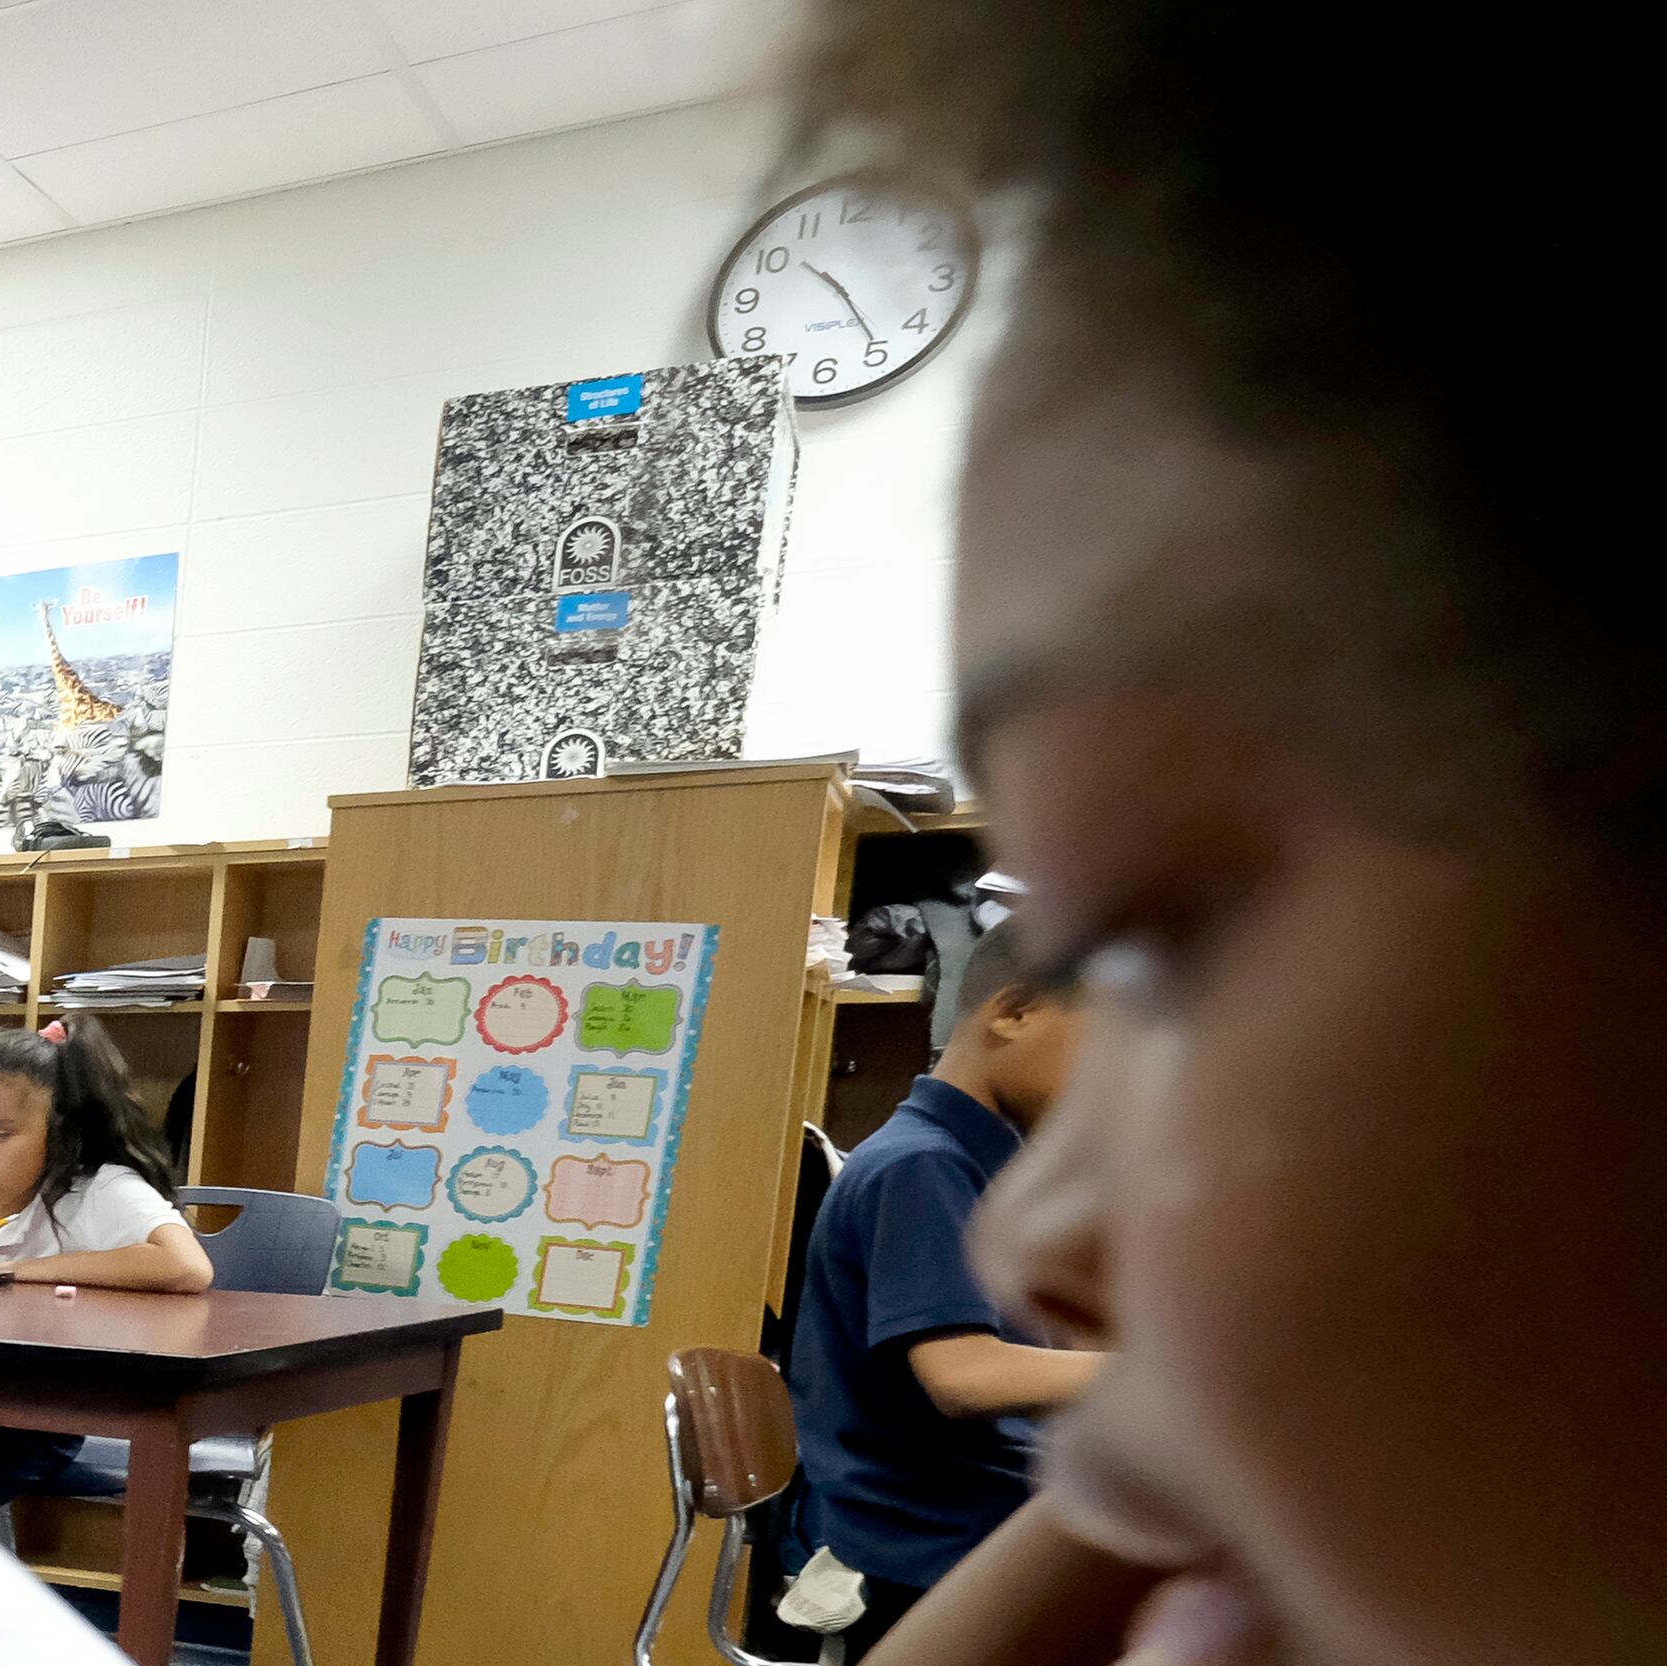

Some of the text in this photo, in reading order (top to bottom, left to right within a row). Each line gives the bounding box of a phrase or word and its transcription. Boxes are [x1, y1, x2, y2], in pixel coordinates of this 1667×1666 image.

[797, 212, 821, 240] 11
[755, 245, 790, 275] 10
[927, 263, 957, 293] 3
[733, 287, 760, 315] 9
[803, 317, 865, 333] VISIPLE
[900, 307, 930, 334] 4
[740, 326, 767, 352] 8
[862, 340, 889, 368] 5
[811, 357, 838, 385] 6
[559, 566, 611, 586] FOSS
[80, 587, 101, 606] Be
[61, 597, 147, 626] Yourself!
[388, 926, 695, 976] Happy Birthday!
